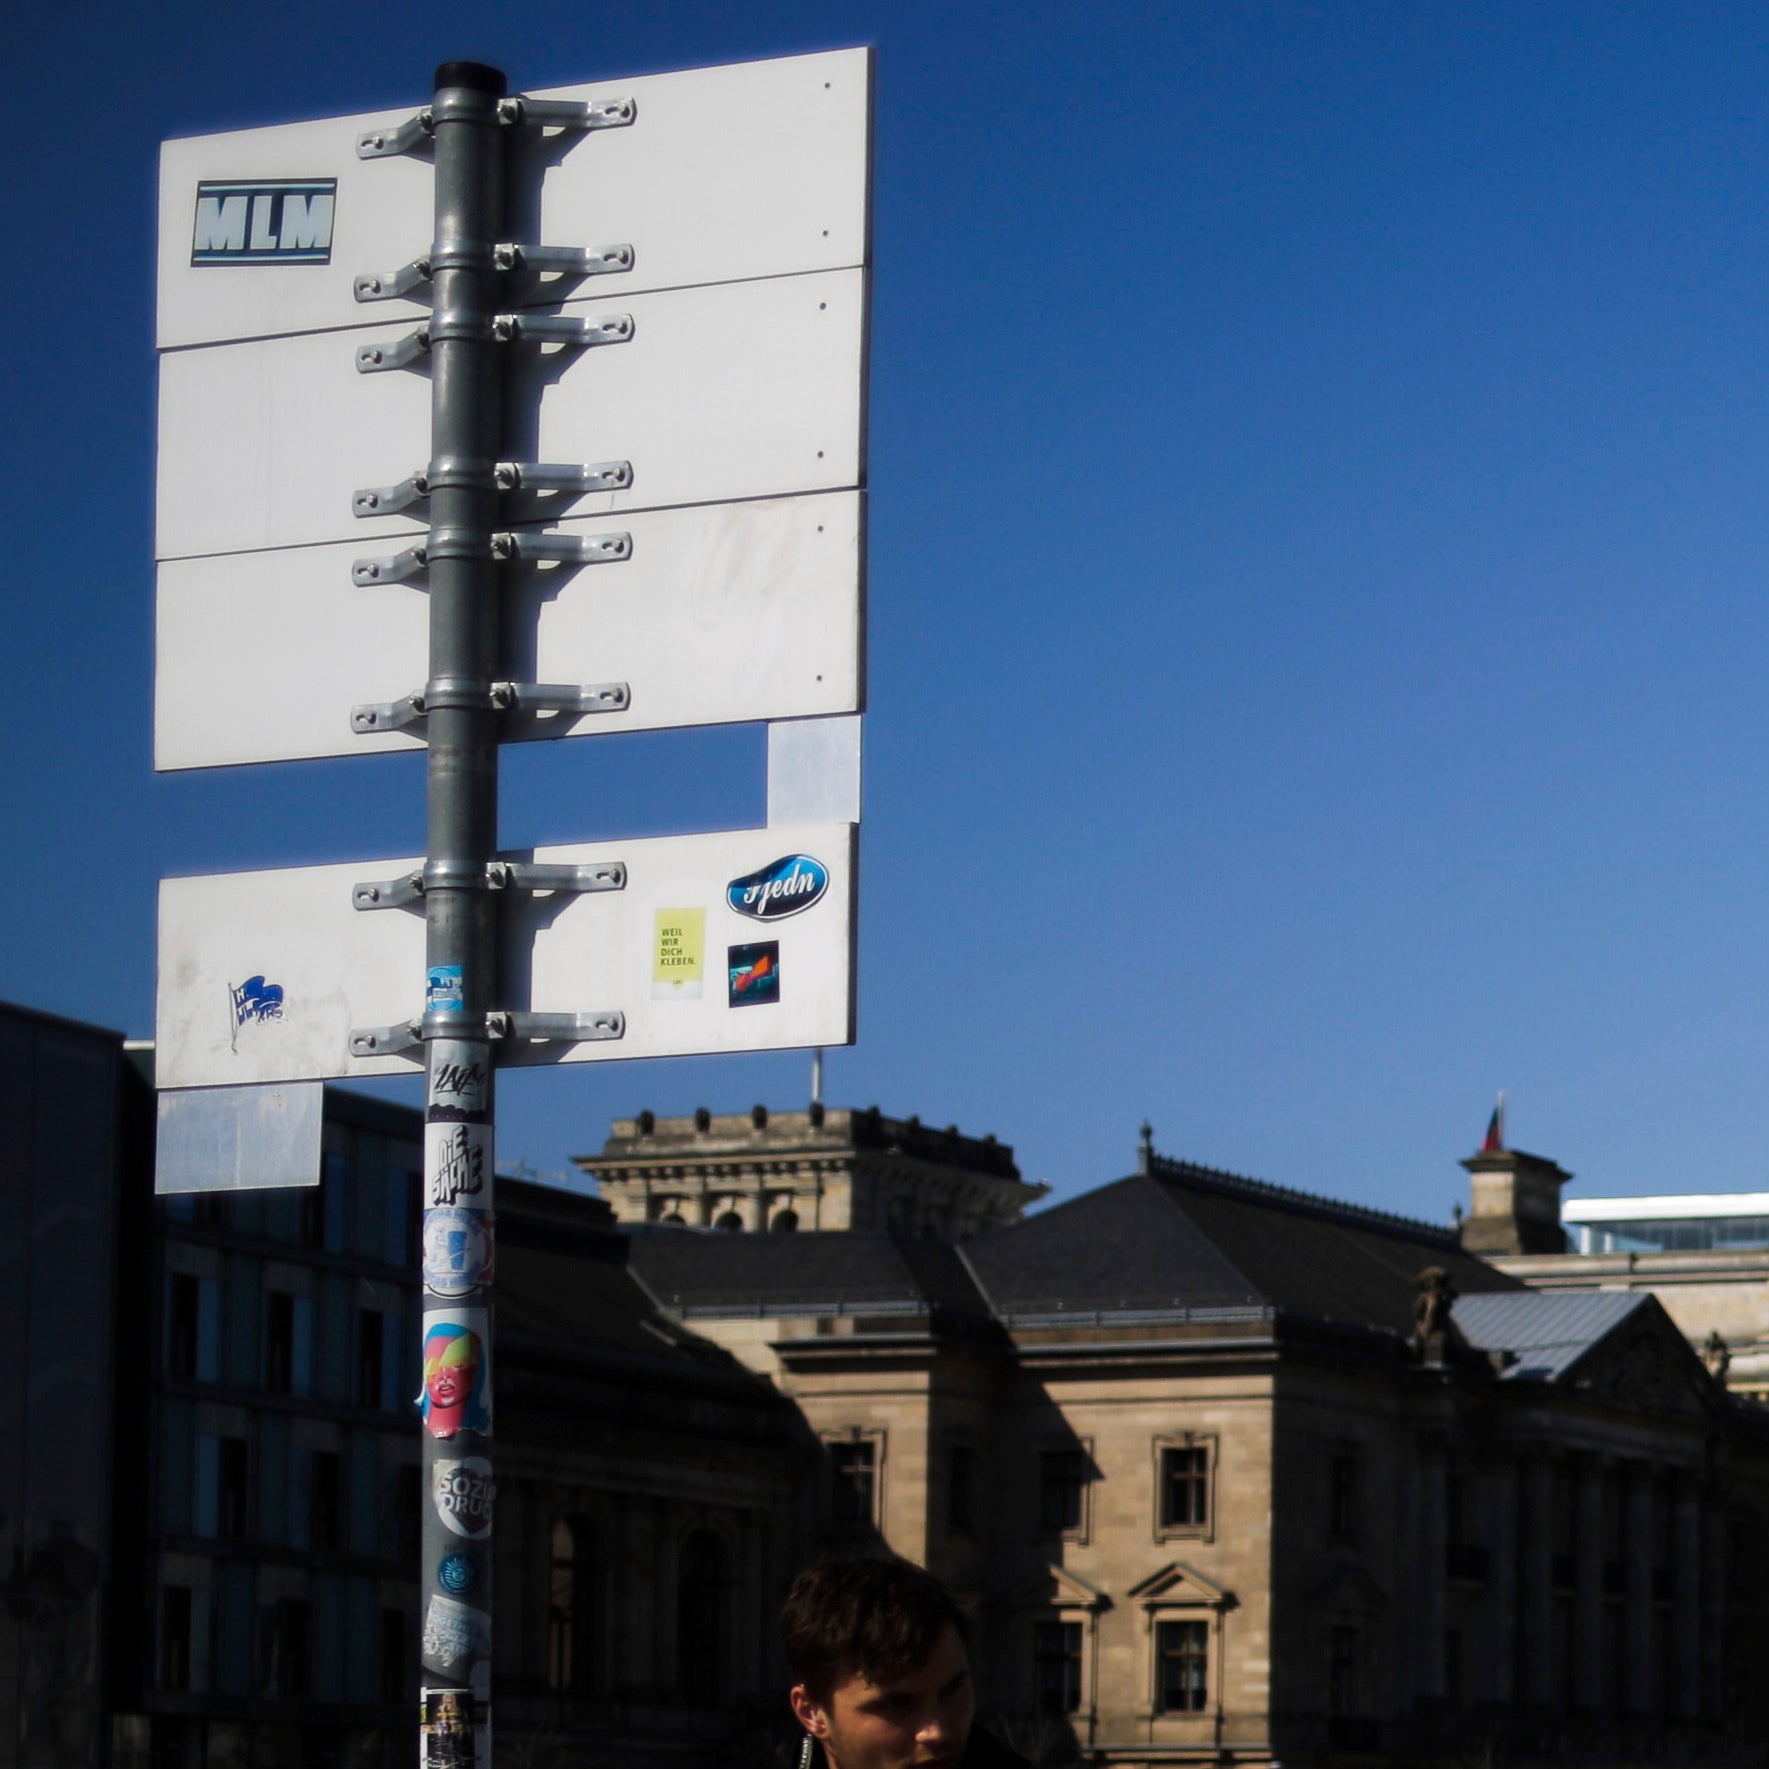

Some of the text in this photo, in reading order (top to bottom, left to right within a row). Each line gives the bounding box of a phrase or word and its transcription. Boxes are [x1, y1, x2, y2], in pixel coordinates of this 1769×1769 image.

[194, 194, 335, 250] MLM
[661, 928, 683, 937] WEIL
[661, 937, 679, 947] WIR
[660, 947, 683, 957] DICH
